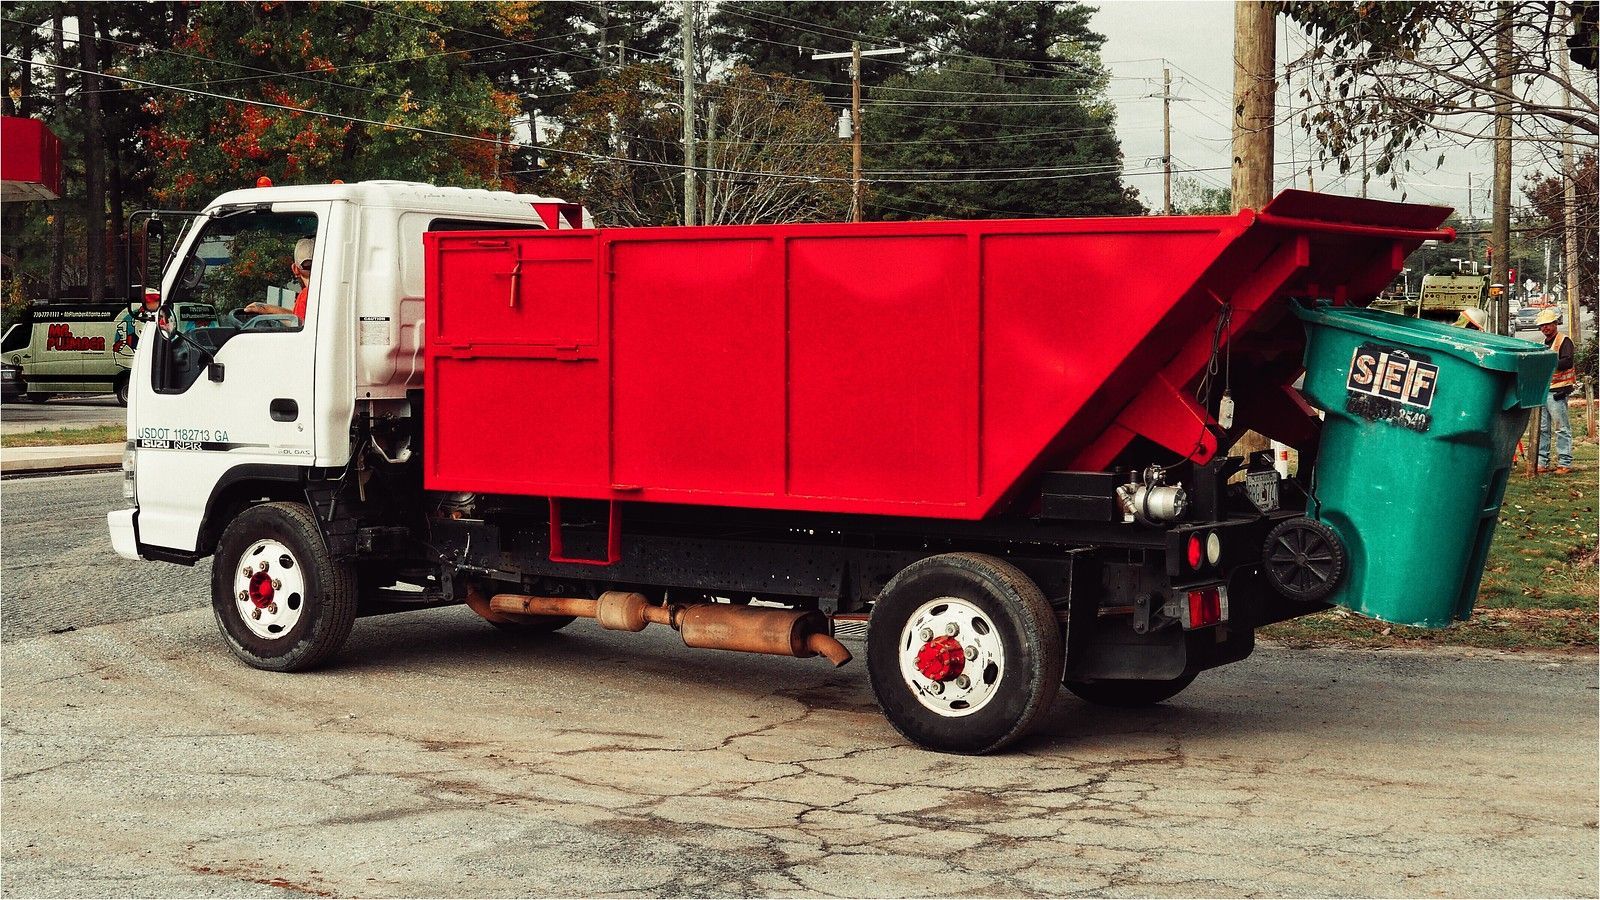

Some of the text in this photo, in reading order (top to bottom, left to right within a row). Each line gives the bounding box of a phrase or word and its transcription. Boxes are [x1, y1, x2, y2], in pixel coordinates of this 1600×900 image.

[137, 427, 229, 442] USDOT 1182713 GA
[141, 439, 203, 450] ISUZU NPR
